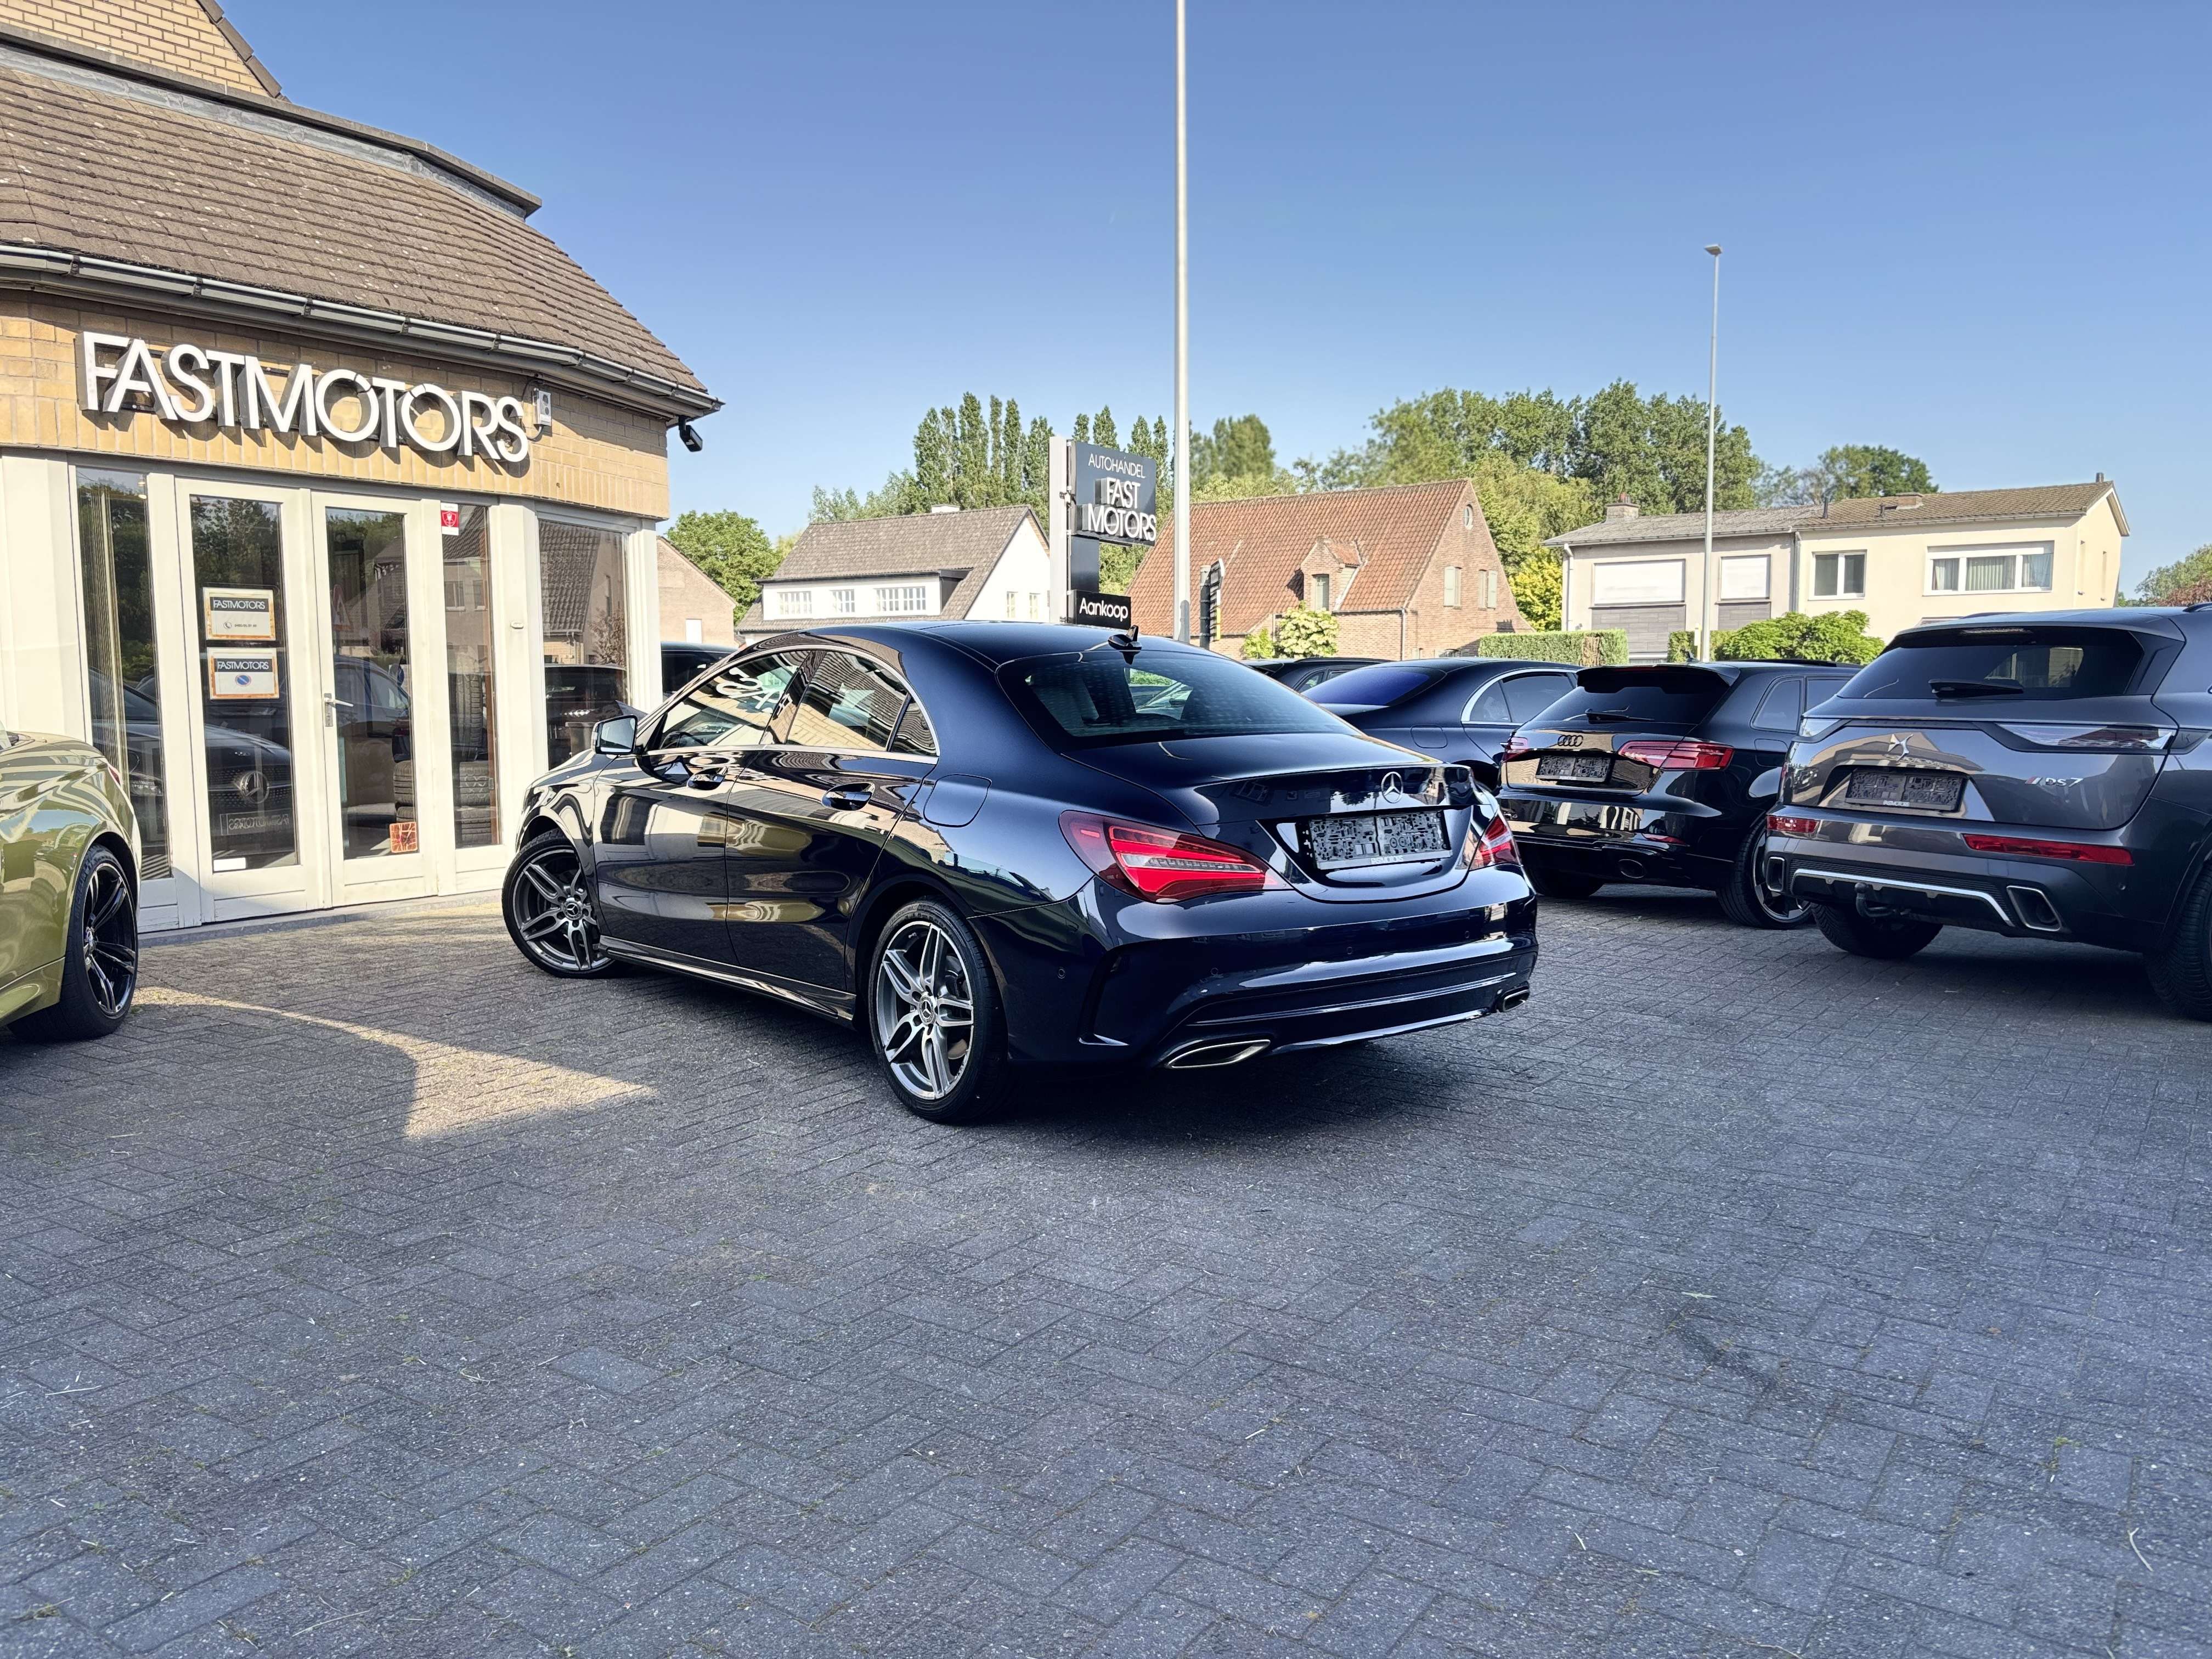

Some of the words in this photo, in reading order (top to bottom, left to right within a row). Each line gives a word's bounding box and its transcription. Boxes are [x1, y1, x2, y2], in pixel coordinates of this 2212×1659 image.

[82, 331, 529, 462] FASTMOTORS
[1088, 453, 1146, 478] AUTOHANDEL
[1106, 477, 1141, 509] FAST
[1088, 503, 1157, 541] MOTORS
[213, 600, 266, 610] FASTMOTORS
[1080, 597, 1128, 622] Aankoop
[217, 661, 269, 670] FASTMOTORS
